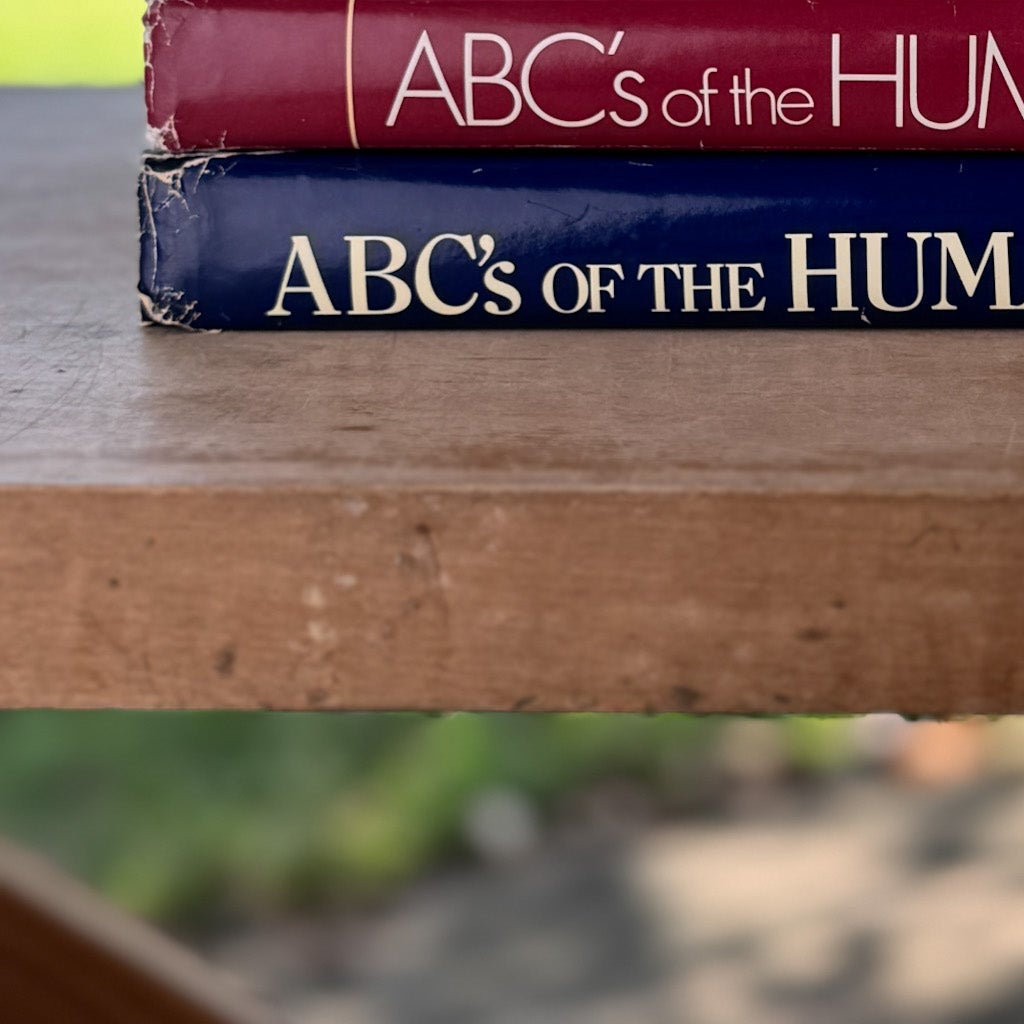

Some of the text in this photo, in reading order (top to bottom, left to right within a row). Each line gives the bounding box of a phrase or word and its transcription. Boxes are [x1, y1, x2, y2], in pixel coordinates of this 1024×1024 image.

[385, 29, 649, 128] ABC's
[661, 67, 719, 127] of
[728, 67, 815, 126] the
[266, 232, 523, 316] ABC's
[541, 262, 625, 315] OF
[636, 262, 767, 314] THE
